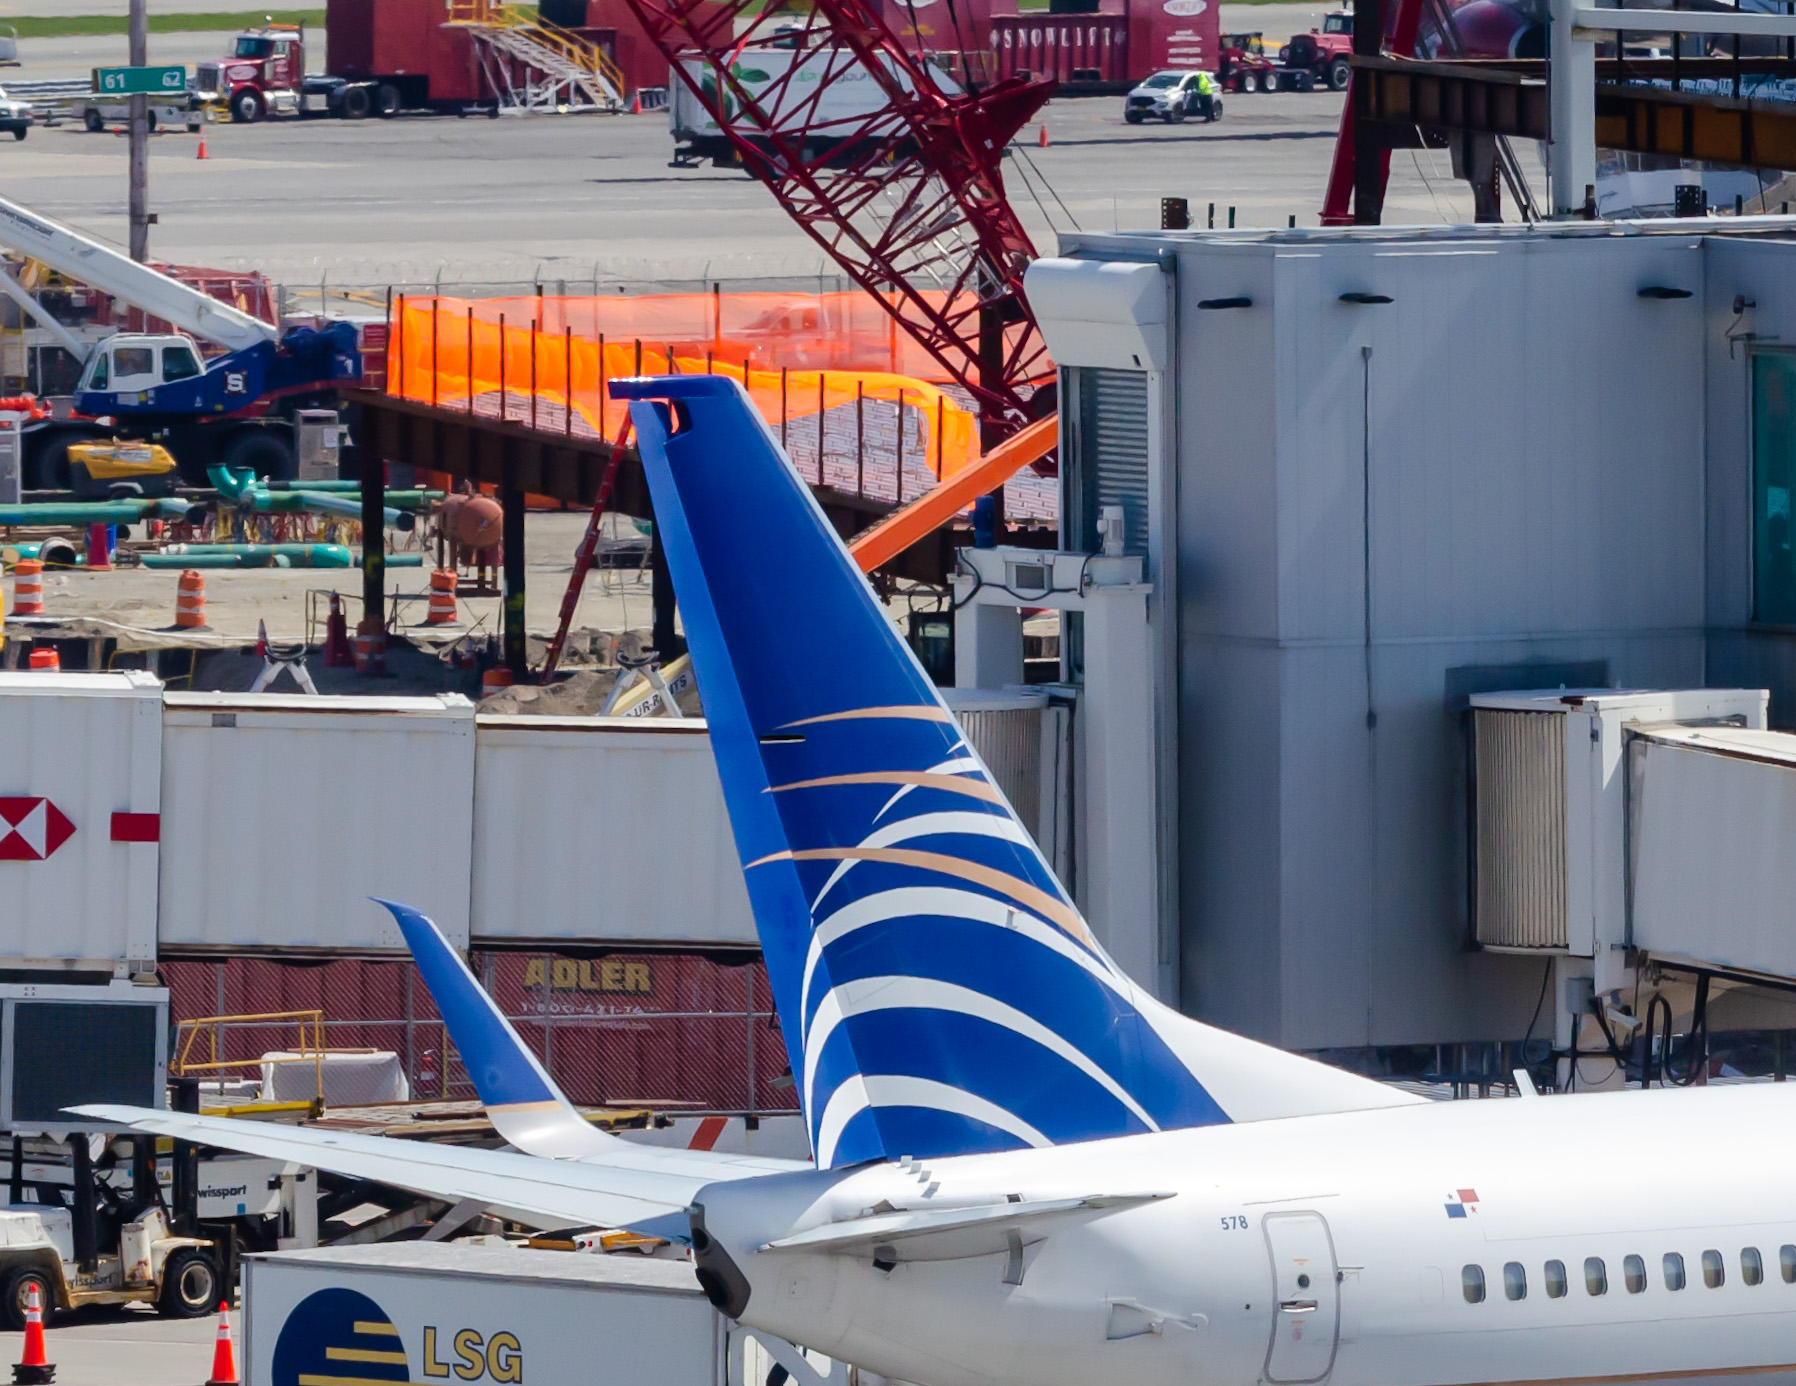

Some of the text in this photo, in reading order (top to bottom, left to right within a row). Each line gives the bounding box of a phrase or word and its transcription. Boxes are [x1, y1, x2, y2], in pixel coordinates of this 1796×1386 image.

[105, 71, 182, 89] 61 62
[227, 373, 244, 393] S
[524, 959, 652, 994] ADLER
[197, 1185, 247, 1200] wissport
[1220, 1215, 1249, 1231] 578
[423, 1326, 523, 1385] LSG
